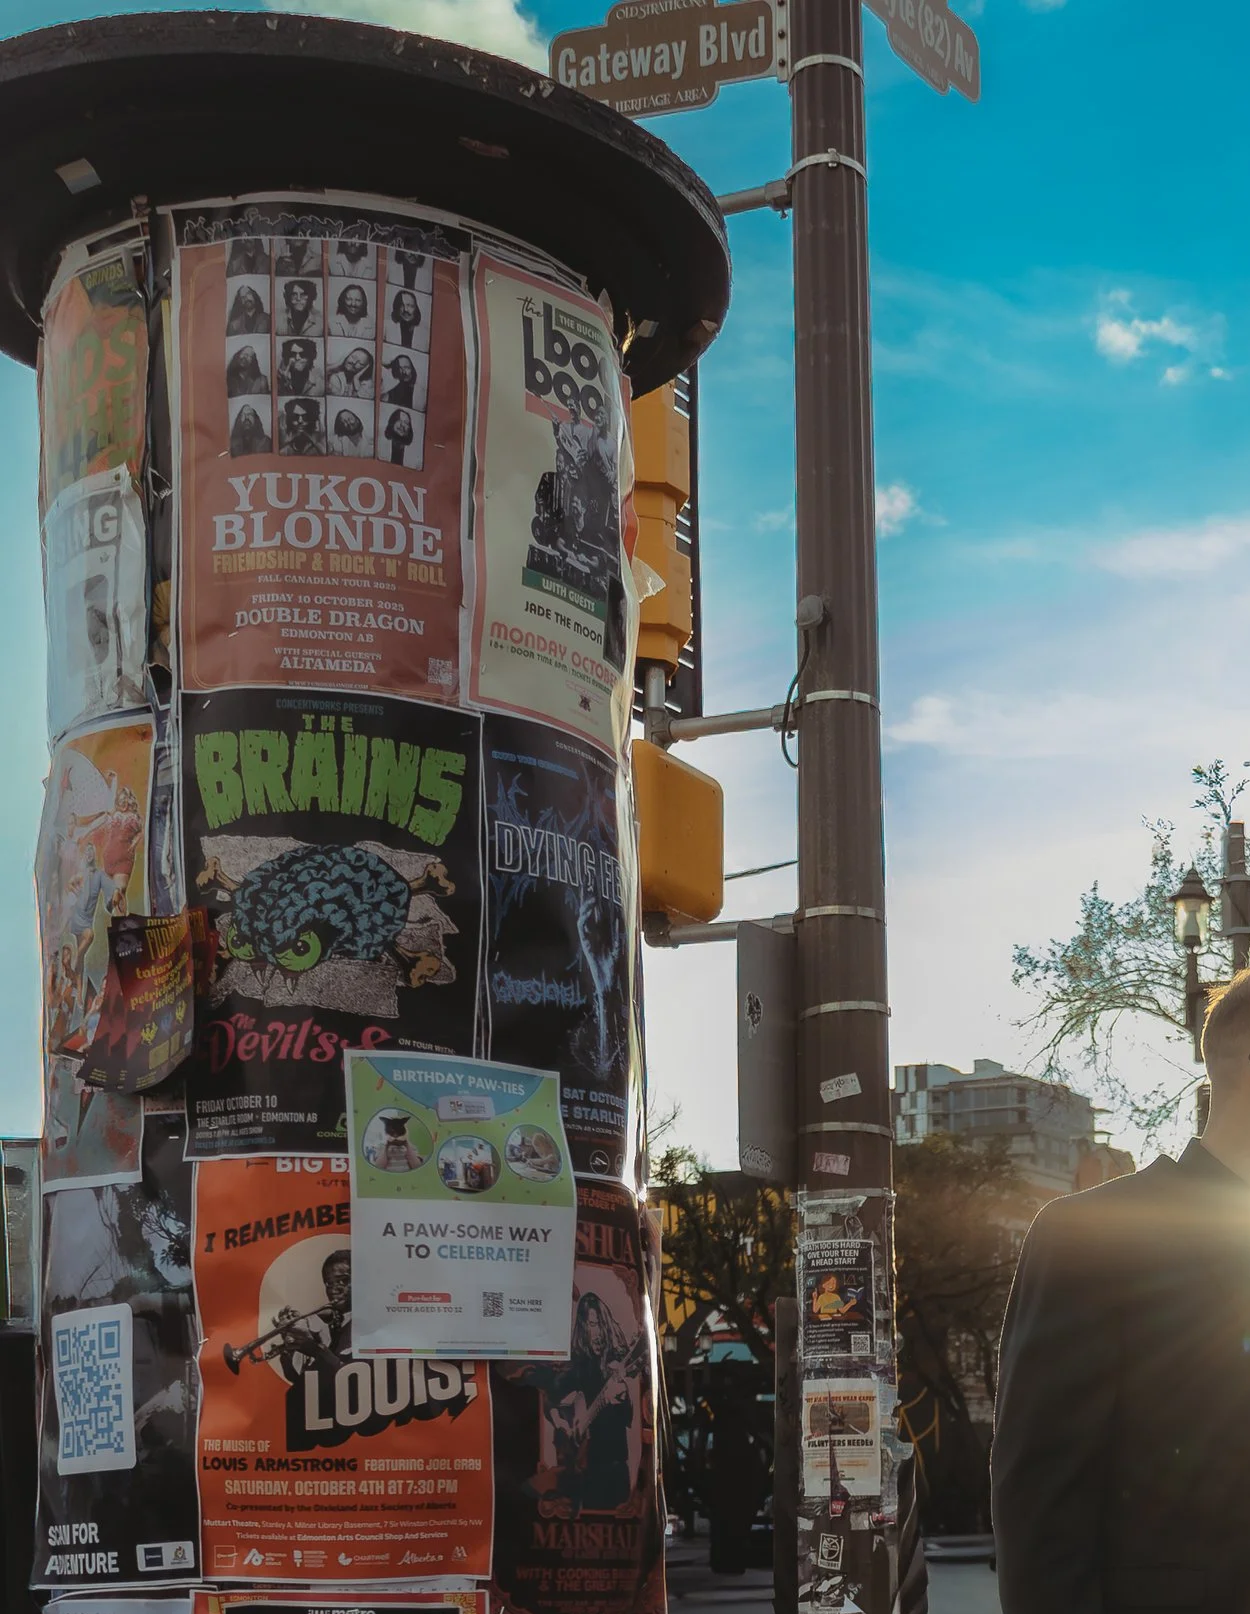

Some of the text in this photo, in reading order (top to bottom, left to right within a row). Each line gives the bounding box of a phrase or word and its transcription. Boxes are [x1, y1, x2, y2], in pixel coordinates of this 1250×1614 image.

[616, 6, 638, 20] OLD
[557, 16, 766, 88] Gateway Blvd
[954, 33, 974, 84] Av
[616, 86, 709, 113] HERITAGE AREA
[559, 314, 575, 330] THE
[228, 472, 428, 523] YUKON
[212, 511, 444, 565] BLONDE
[213, 550, 448, 588] FRIENDSHIP & ROCK ROLL
[258, 574, 396, 592] FALL CANADIAN TOUR 2025
[251, 593, 405, 613] FRIDAY 10 OCTOBER 2025
[541, 577, 597, 612] WITH GUESTS
[235, 607, 425, 636] DOUBLE DRAGON
[524, 600, 603, 646] JADE THE MOON
[280, 627, 375, 644] EDMONTON AB
[490, 620, 568, 662] MONDAY
[274, 647, 382, 661] WITH SPECIAL GUESTS
[280, 655, 377, 675] ALTAMEDA
[276, 698, 385, 717] CONCERTWORKS PRESENTS
[302, 714, 354, 733] THE
[195, 729, 467, 847] BRAINS
[494, 820, 596, 893] DYING
[208, 1016, 340, 1075] Devil's
[398, 1038, 433, 1052] ON TOUR
[392, 1068, 526, 1096] BIRTHDAY PAW-TIES
[563, 1087, 587, 1101] SAT
[195, 1095, 278, 1114] FRIDAY OCTOBER 10
[196, 1112, 305, 1129] THE EDMONTON
[275, 1157, 324, 1174] BIG
[204, 1203, 351, 1253] I REMEMBE
[382, 1222, 552, 1244] A PAW-SOME WAY
[404, 1243, 531, 1263] TO CELEBRATE!
[821, 1249, 860, 1258] YOUR TEEN
[834, 1257, 857, 1266] START
[527, 1298, 543, 1307] HERE
[203, 1438, 271, 1453] THE MUSIC OF
[202, 1456, 358, 1473] LOUIS ARMSTRONG
[294, 1478, 458, 1497] OCTOBER 4TH 7:30 PM
[71, 1522, 101, 1546] FOR
[296, 1532, 385, 1542] Edmonton Council
[44, 1551, 120, 1576] ADVENTURE
[556, 1567, 610, 1580] COOKING
[555, 1579, 619, 1592] THE GREAT
